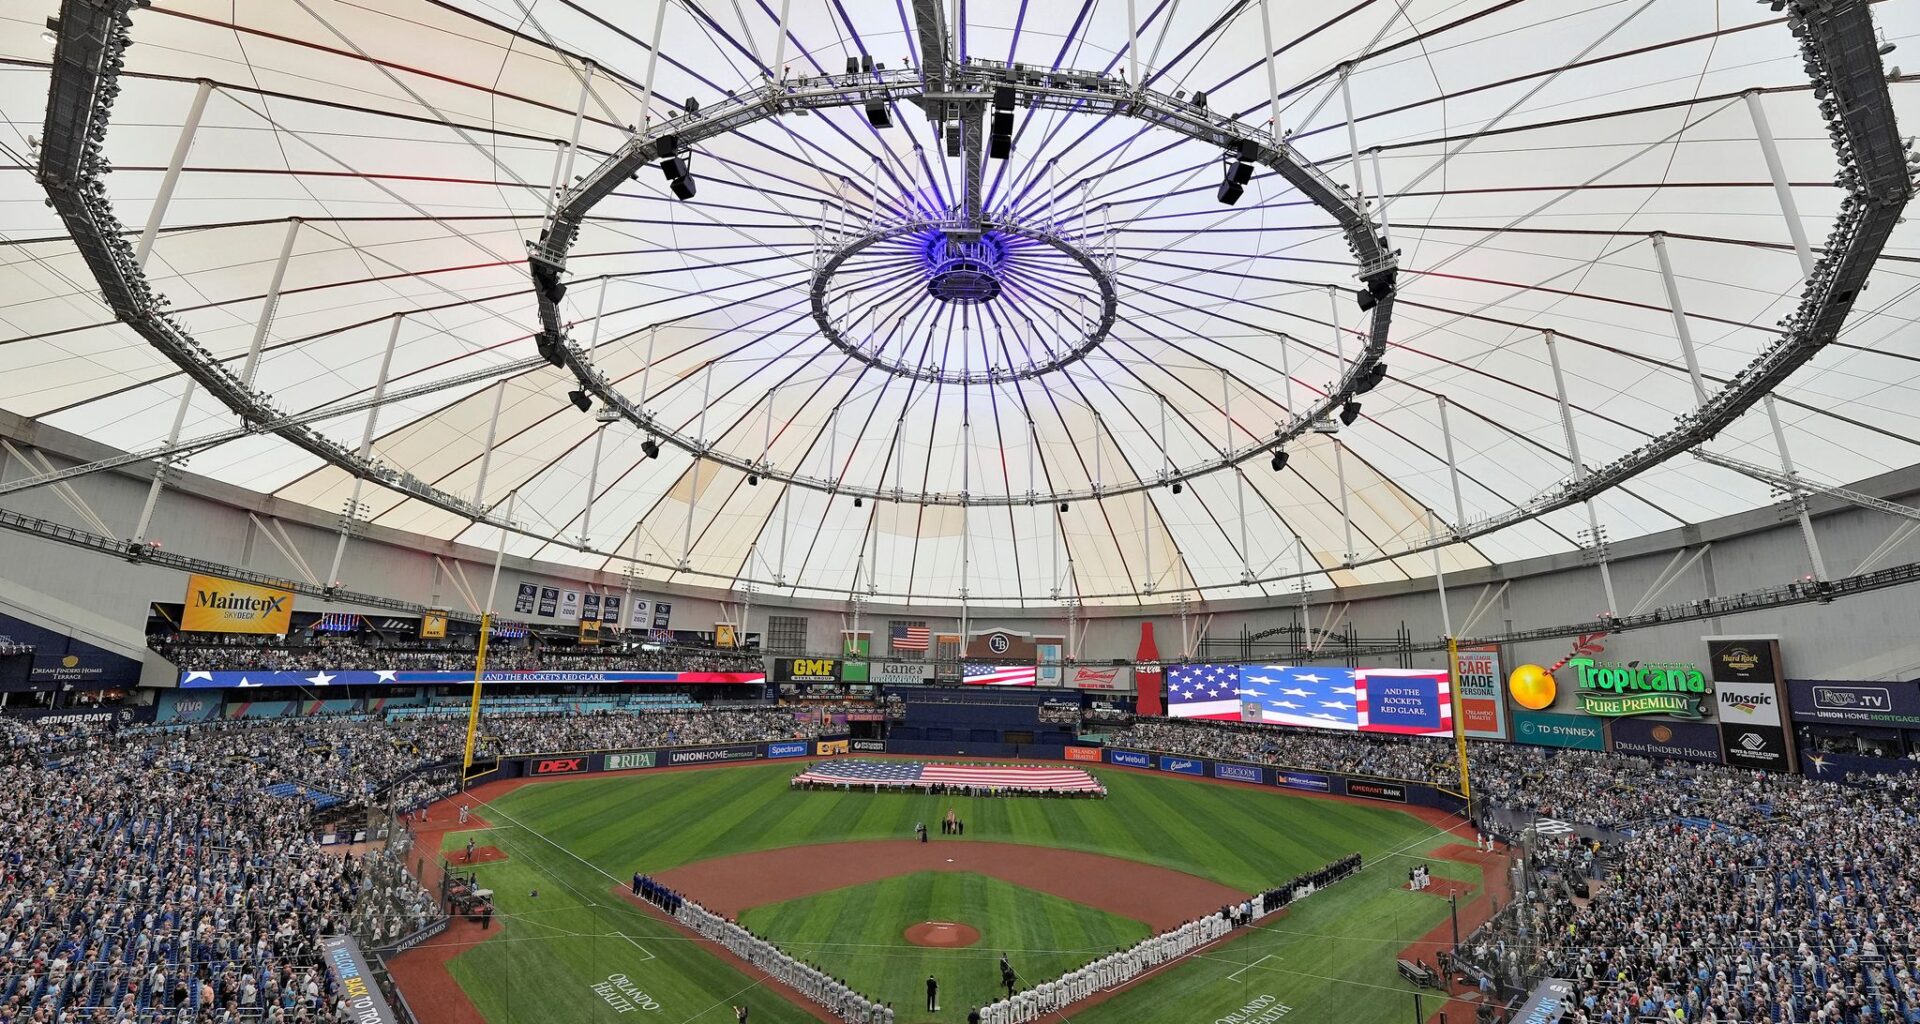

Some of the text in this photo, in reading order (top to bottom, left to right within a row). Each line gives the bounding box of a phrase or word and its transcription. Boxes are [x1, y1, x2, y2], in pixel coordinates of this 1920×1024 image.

[194, 590, 286, 618] MaintenX
[1722, 654, 1759, 663] Hard Rock
[793, 659, 835, 676] GMF
[1458, 661, 1493, 675] CARE
[484, 673, 504, 681] AND
[504, 673, 522, 681] THE
[562, 673, 578, 681] RED
[1459, 675, 1495, 688] MADE
[1568, 657, 1705, 694] Tropicana
[1402, 688, 1421, 696] THE
[1460, 687, 1495, 696] PERSONAL
[1585, 697, 1688, 713] PURE PREMIUM
[1721, 692, 1772, 705] Mosaic
[176, 701, 204, 712] VIVA
[1380, 706, 1397, 714] RED
[41, 712, 113, 725] SOMOS RAYS
[1817, 711, 1844, 719] UNION
[1844, 712, 1870, 720] HOME
[1870, 713, 1920, 723] MORTGAGE
[1537, 724, 1596, 737] TD SYNNEX
[771, 745, 801, 755] Spectrum
[1615, 741, 1718, 758] DREAM FINDERS HOMES
[538, 759, 582, 773] DEX
[621, 754, 651, 768] RIPA
[1124, 755, 1146, 764] Webull
[1351, 784, 1401, 797] AMERANT BANK
[331, 947, 360, 979] WELCOME
[344, 977, 369, 998] BACK
[607, 973, 660, 1011] ORLANDO
[352, 996, 374, 1009] TO
[590, 981, 635, 1013] HEALTH
